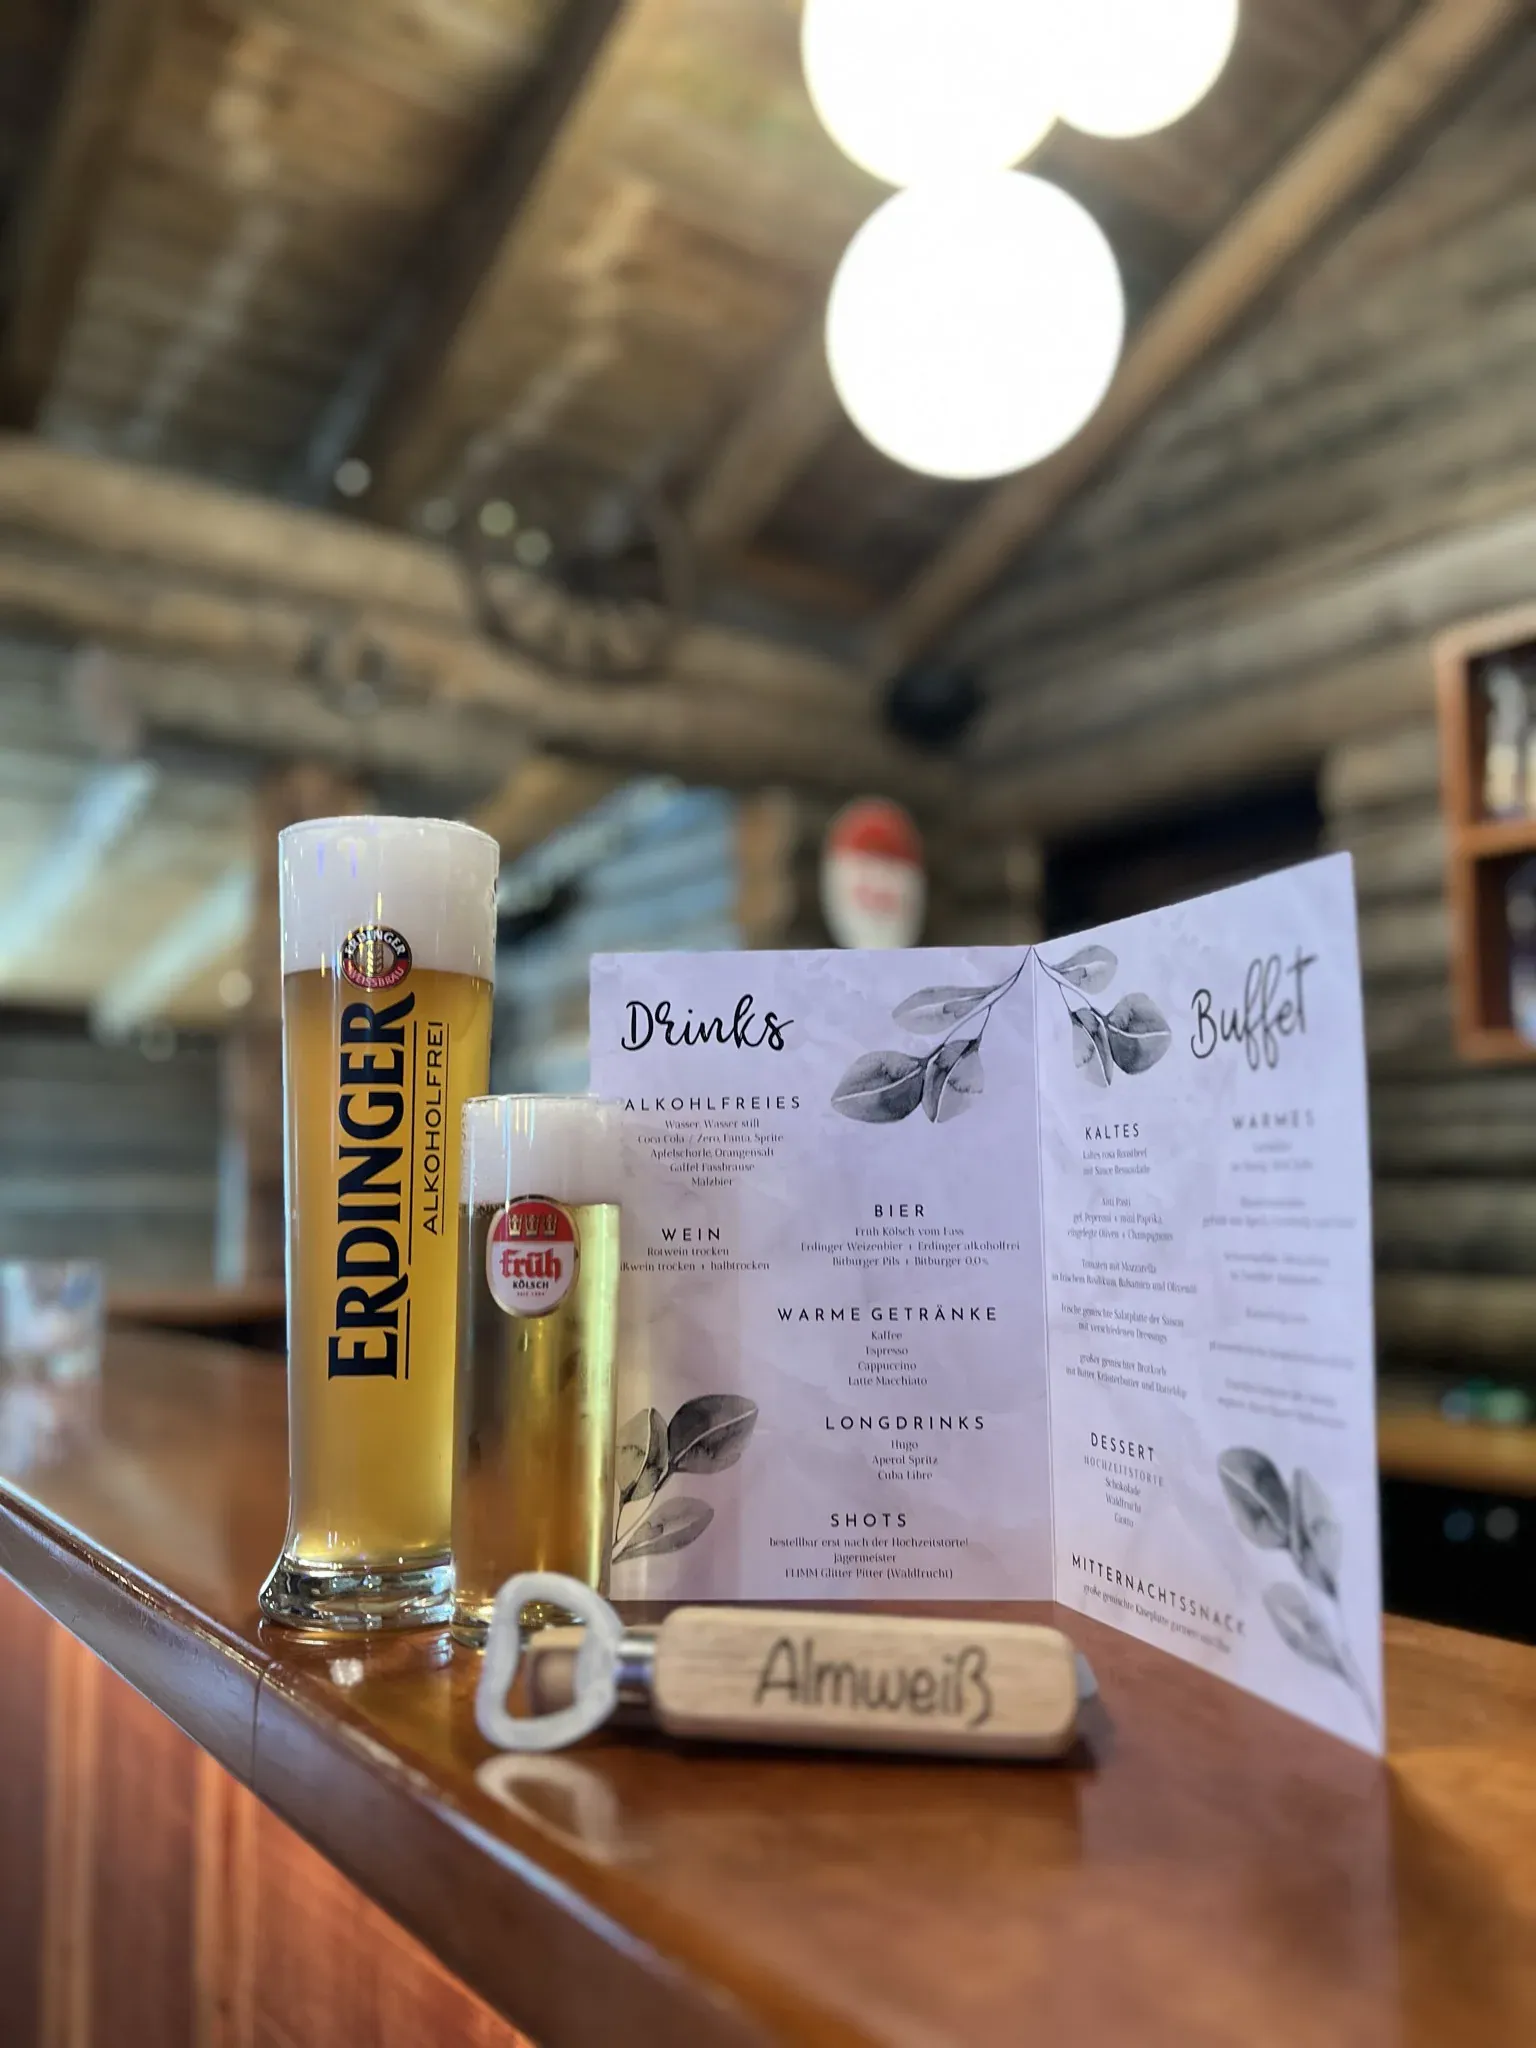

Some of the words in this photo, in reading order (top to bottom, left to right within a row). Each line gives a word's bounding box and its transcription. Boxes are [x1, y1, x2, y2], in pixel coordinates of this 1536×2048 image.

[345, 929, 406, 956] ERDINGER
[1190, 946, 1318, 1071] Buffet
[621, 994, 794, 1051] Drinks
[625, 1096, 800, 1111] ALKOHLFREIES
[704, 1119, 738, 1129] Wasser
[741, 1118, 760, 1128] still
[1232, 1109, 1315, 1130] WARMES
[422, 1021, 444, 1235] ALKOHOLFREI
[1085, 1123, 1140, 1141] KALTES
[638, 1134, 661, 1144] Coca
[663, 1133, 685, 1144] Cola
[754, 1132, 784, 1144] Sprite
[715, 1147, 775, 1159] Orangensaft
[670, 1162, 699, 1172] Gaffel
[702, 1162, 755, 1172] Fassbrause
[328, 991, 415, 1380] ERDINGER
[691, 1176, 734, 1187] Malzbier
[874, 1204, 925, 1218] BIER
[662, 1227, 720, 1242] WEIN
[882, 1226, 915, 1236] Kölsch
[943, 1226, 964, 1236] Fass
[647, 1246, 688, 1256] Rotwein
[691, 1246, 729, 1256] trocken
[801, 1241, 843, 1253] Erdinger
[846, 1241, 904, 1251] Weizenbier
[918, 1241, 961, 1253] Erdinger
[963, 1240, 1020, 1250] alkoholfrei
[657, 1261, 696, 1271] trocken
[710, 1260, 770, 1271] halbtrocken
[832, 1256, 879, 1268] Bitburger
[882, 1256, 900, 1266] Pils
[914, 1256, 961, 1268] Bitburger
[513, 1279, 549, 1290] KÖLSCH
[777, 1307, 861, 1321] WARME
[871, 1304, 997, 1321] GETRÄNKE
[871, 1330, 902, 1340] Kaffee
[866, 1346, 909, 1356] Espresso
[858, 1361, 917, 1372] Cappuccino
[848, 1376, 873, 1386] Latte
[875, 1376, 928, 1386] Macchiato
[825, 1415, 985, 1431] LONGDRINKS
[890, 1439, 919, 1451] Hugo
[1091, 1432, 1155, 1462] DESSERT
[872, 1454, 906, 1466] Aperol
[908, 1454, 939, 1466] Spritz
[878, 1469, 904, 1480] Cuba
[906, 1469, 933, 1480] Libre
[1083, 1455, 1164, 1487] HOCHZEITSTORTE
[830, 1513, 907, 1528] SHOTS
[769, 1536, 818, 1548] bestellbar
[821, 1537, 841, 1547] erst
[844, 1536, 869, 1547] nach
[871, 1536, 888, 1547] der
[1072, 1552, 1246, 1637] MITTERNACHTSSNACK
[754, 1636, 995, 1728] Almweiß
